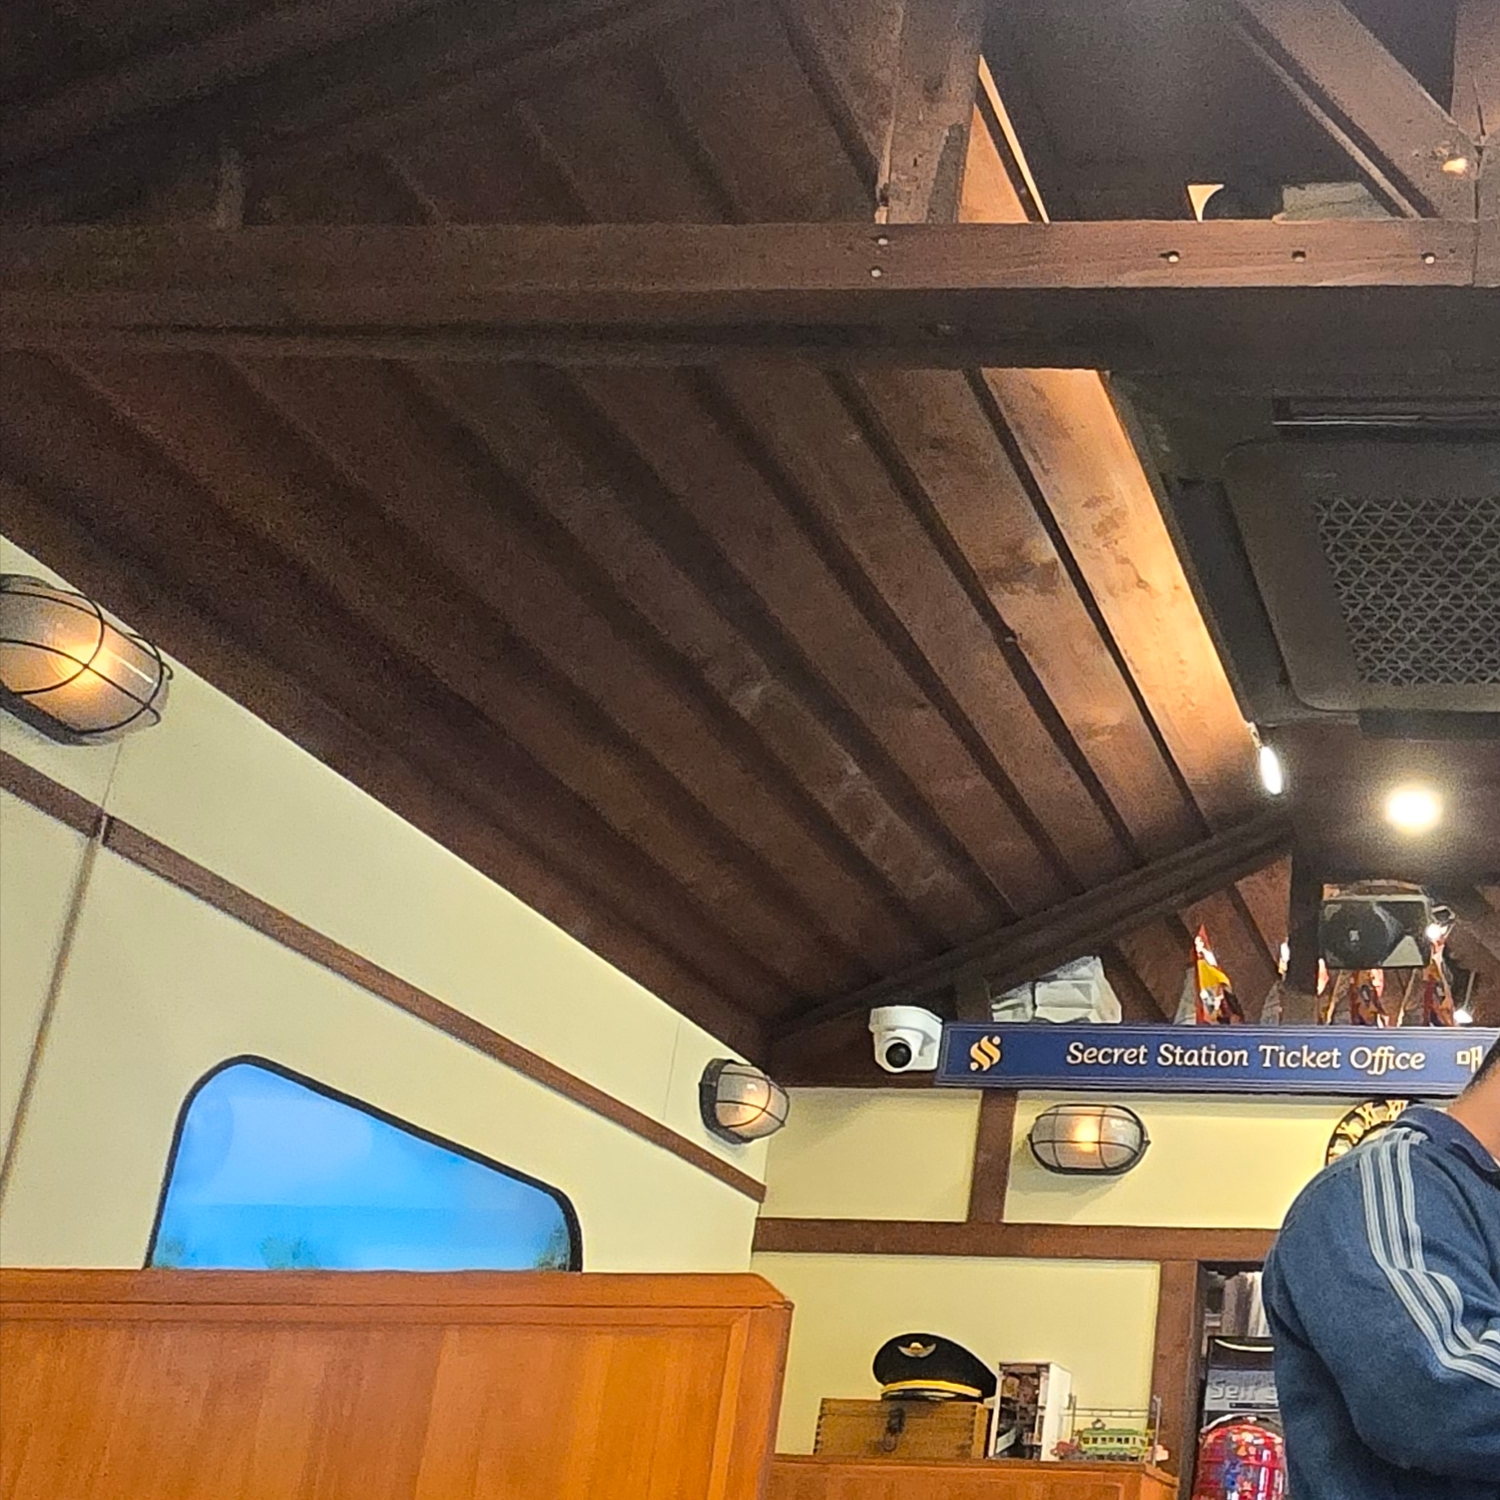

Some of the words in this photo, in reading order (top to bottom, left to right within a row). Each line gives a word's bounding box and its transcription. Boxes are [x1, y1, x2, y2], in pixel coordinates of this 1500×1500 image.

[1066, 1042, 1148, 1067] Secret
[1157, 1043, 1249, 1067] Station
[1259, 1045, 1341, 1069] Ticket
[1349, 1046, 1426, 1075] Office
